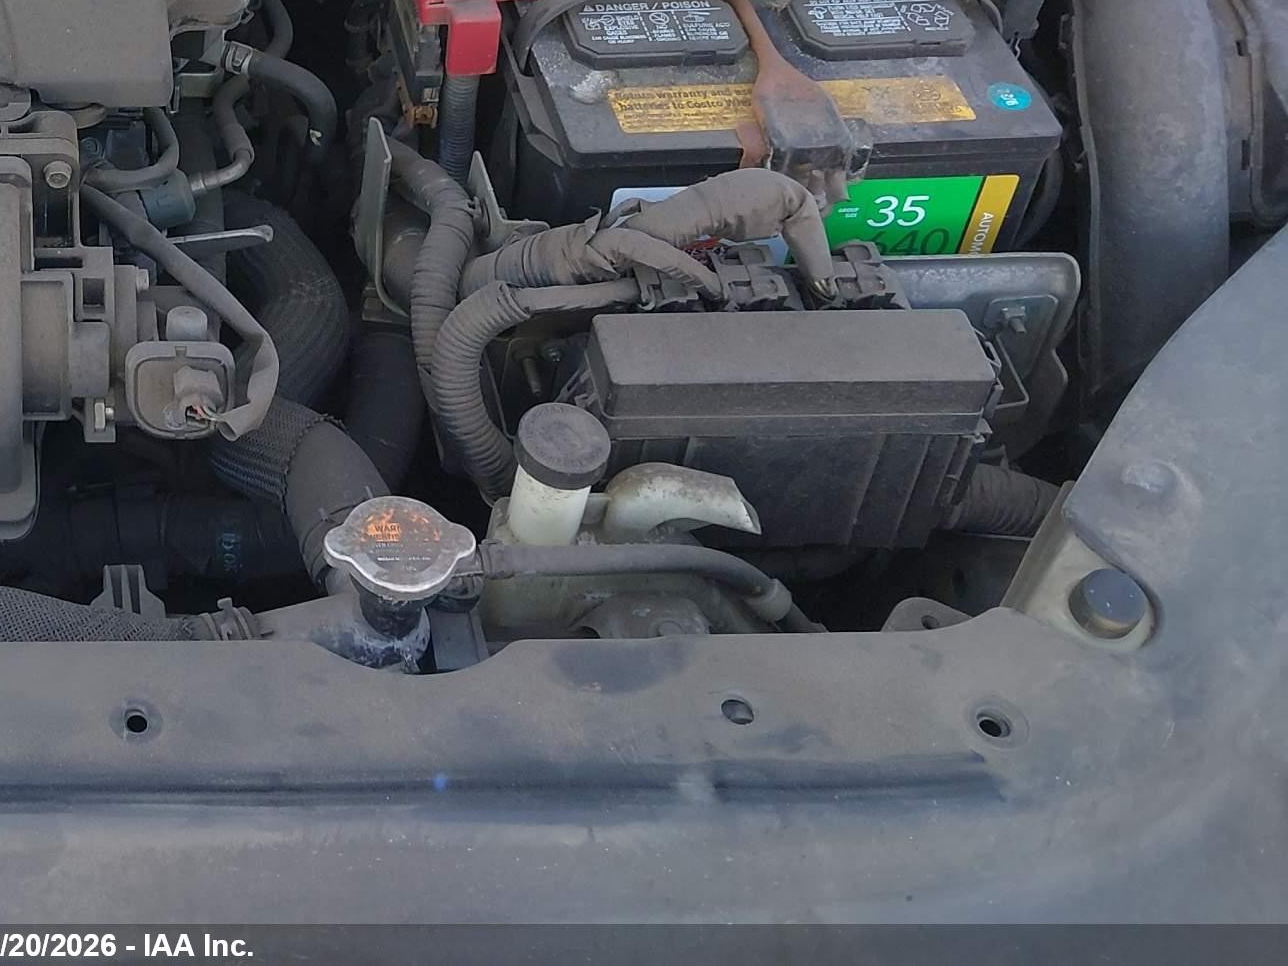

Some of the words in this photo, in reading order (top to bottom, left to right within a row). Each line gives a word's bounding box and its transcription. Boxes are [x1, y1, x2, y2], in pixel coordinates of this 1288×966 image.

[595, 2, 649, 12] DANGER
[663, 0, 711, 9] POISON
[656, 89, 708, 99] warranty
[672, 101, 684, 110] to
[686, 100, 722, 109] Costco
[866, 195, 930, 227] 35
